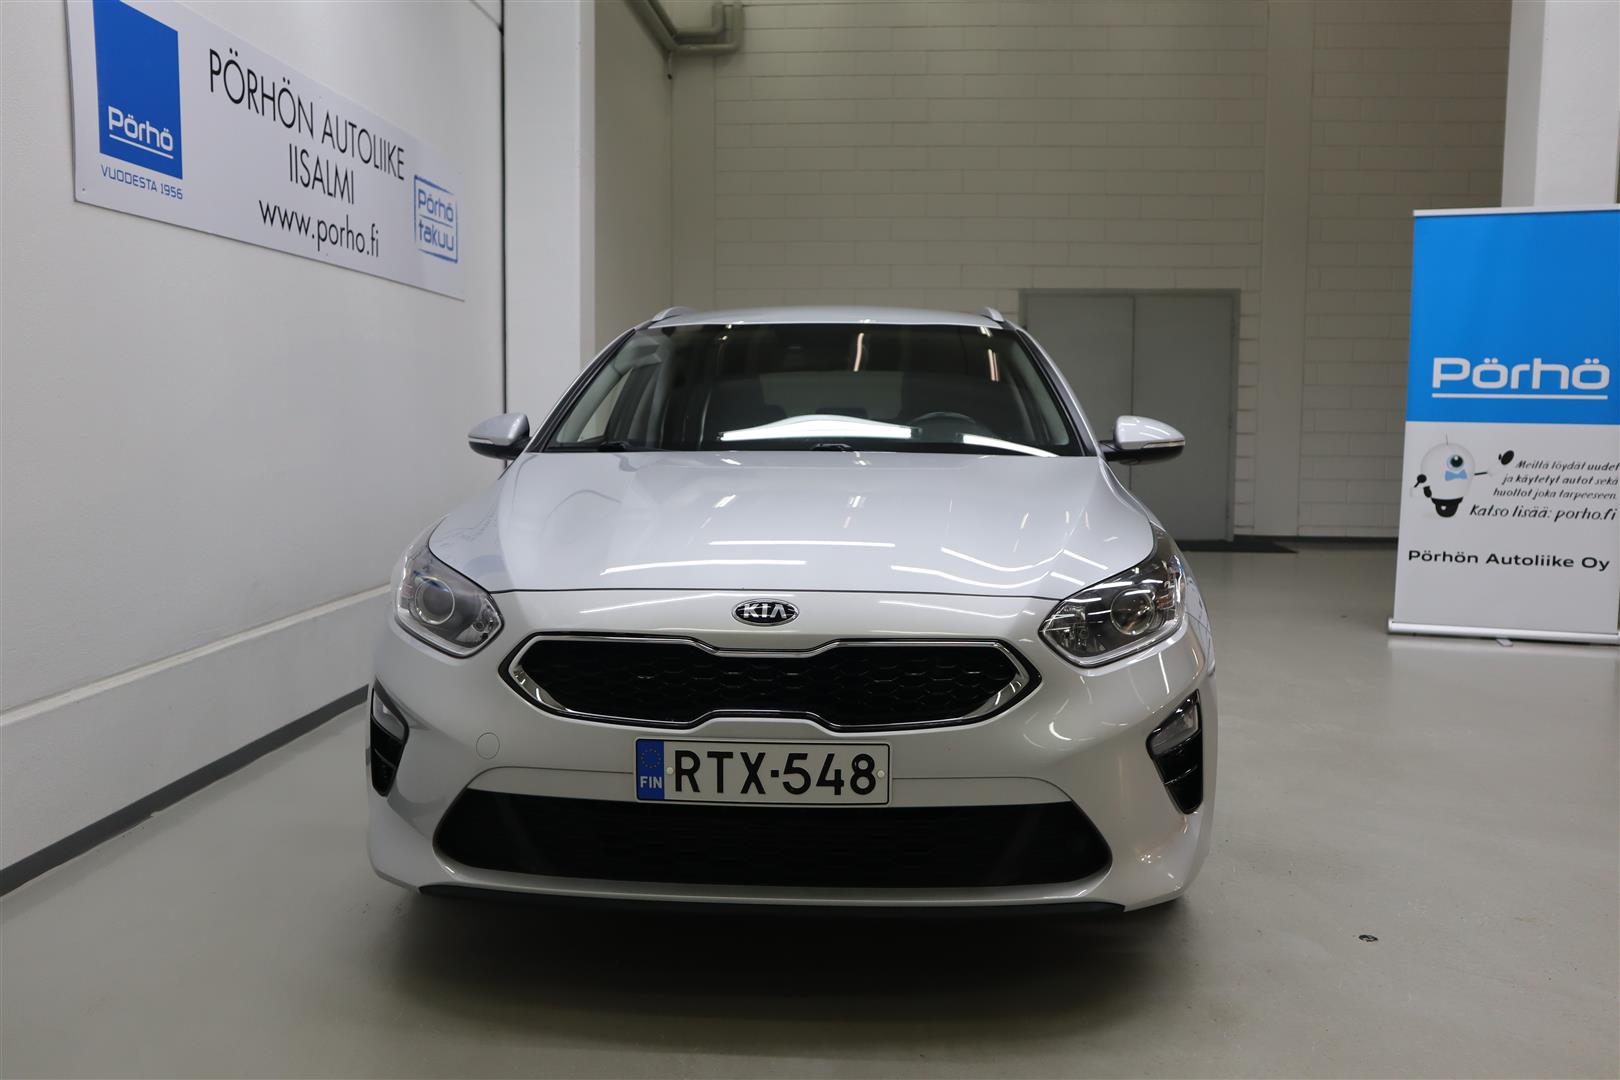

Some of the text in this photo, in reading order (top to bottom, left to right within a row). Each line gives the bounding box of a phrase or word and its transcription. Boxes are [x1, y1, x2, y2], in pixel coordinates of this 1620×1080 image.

[108, 105, 173, 152] Pörhö
[209, 47, 405, 181] PÖRHÖN AUTOLIIKE
[101, 164, 184, 200] VUODESTA 1956
[289, 143, 354, 205] IISALMI
[417, 187, 454, 222] Pörhö
[258, 199, 379, 258] www.porho.fi
[418, 219, 455, 252] takuu
[1431, 356, 1611, 391] Pörhö
[1501, 473, 1513, 486] ja
[1515, 474, 1561, 486] käytetyt
[1562, 475, 1594, 486] autot
[1587, 461, 1620, 472] uudet
[1493, 487, 1533, 497] huollot
[1532, 488, 1557, 500] joka
[1469, 503, 1618, 522] Katso lisää: porho.fi
[1408, 549, 1611, 571] Pörhön Autoliike Oy
[743, 603, 787, 619] KIA
[640, 776, 662, 789] FIN
[674, 749, 877, 796] RTX-548
